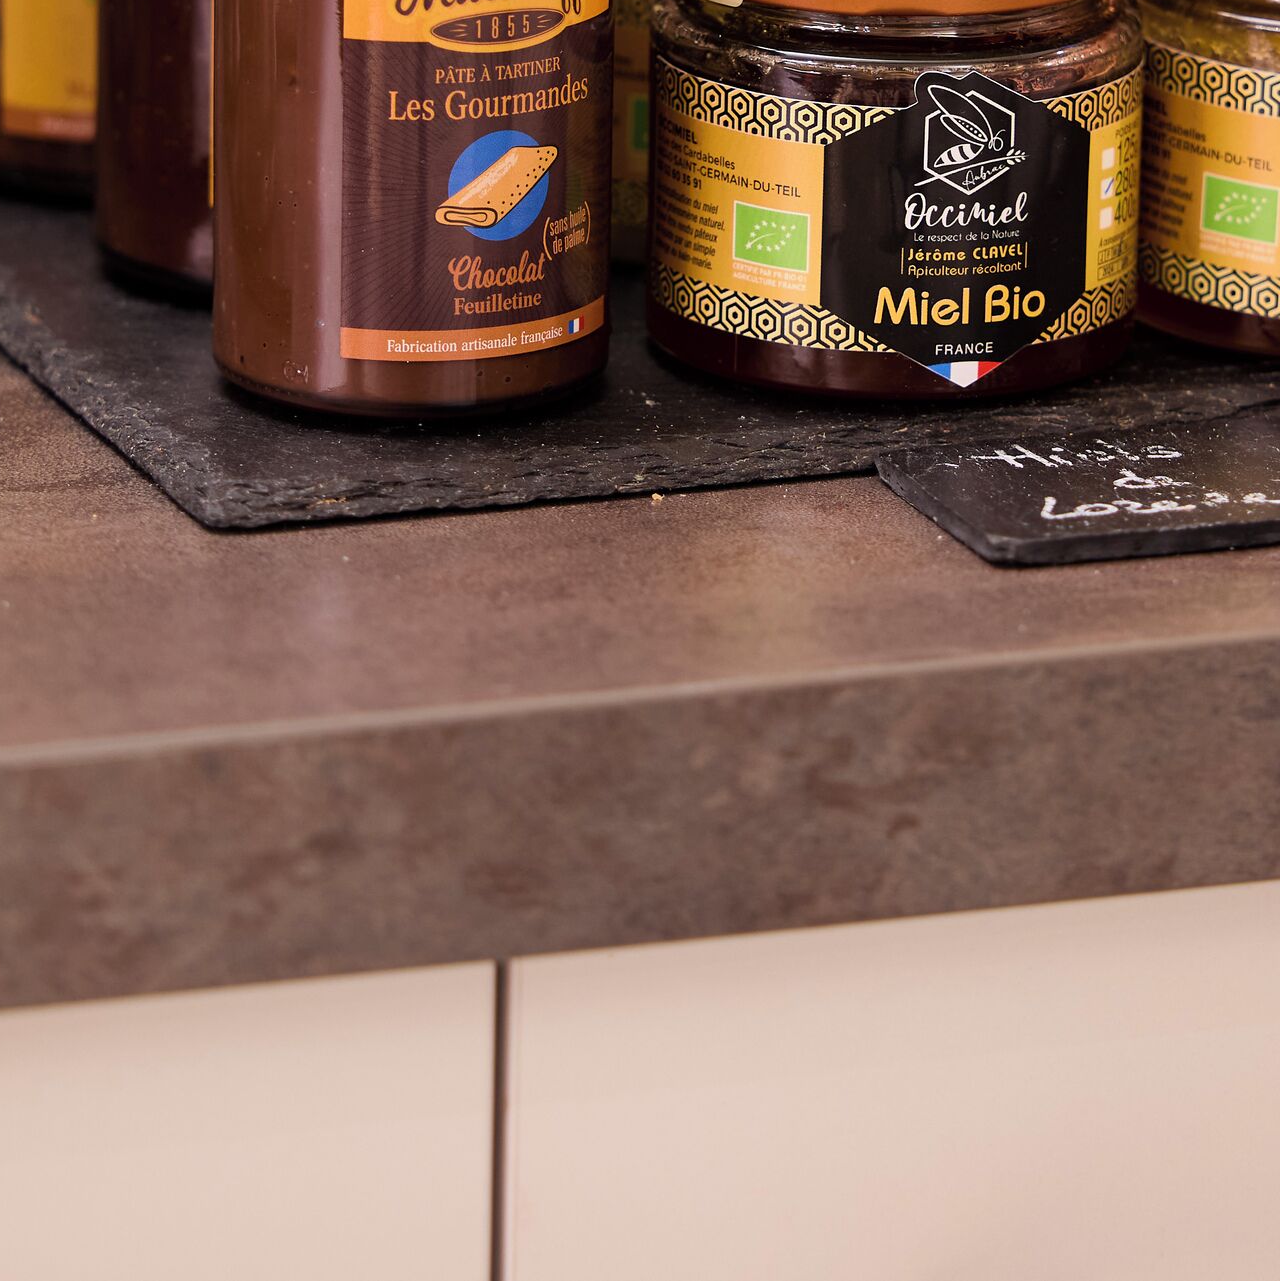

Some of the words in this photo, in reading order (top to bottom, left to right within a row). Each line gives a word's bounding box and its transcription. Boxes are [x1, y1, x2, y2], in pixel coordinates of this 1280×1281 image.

[475, 15, 530, 39] 1855
[435, 66, 476, 84] PÂTE
[480, 64, 491, 81] À
[496, 59, 561, 80] TARTINER
[388, 90, 435, 121] Les
[445, 73, 589, 120] Gourmandes
[684, 145, 736, 170] Cardabelles
[673, 154, 801, 198] SAINT-GERMAIN-DU-TEIL
[693, 177, 702, 189] 91
[962, 164, 1005, 191] Aubrac
[904, 191, 1029, 230] Occimiel
[553, 236, 563, 255] de
[914, 233, 925, 242] Le
[927, 233, 962, 243] respect
[965, 231, 978, 241] de
[980, 230, 990, 240] la
[991, 228, 1020, 239] Nature
[908, 248, 966, 261] Jérôme
[972, 243, 1023, 260] CLAVEL
[448, 250, 545, 291] Chocolat
[908, 264, 969, 279] Apiculteur
[972, 261, 1022, 275] récoltant
[454, 293, 542, 316] Feuilletine
[874, 286, 970, 326] Miel
[984, 284, 1046, 323] Bio
[387, 339, 457, 354] Fabrication
[462, 334, 517, 351] artisanale
[521, 326, 563, 345] française
[935, 342, 994, 356] FRANCE
